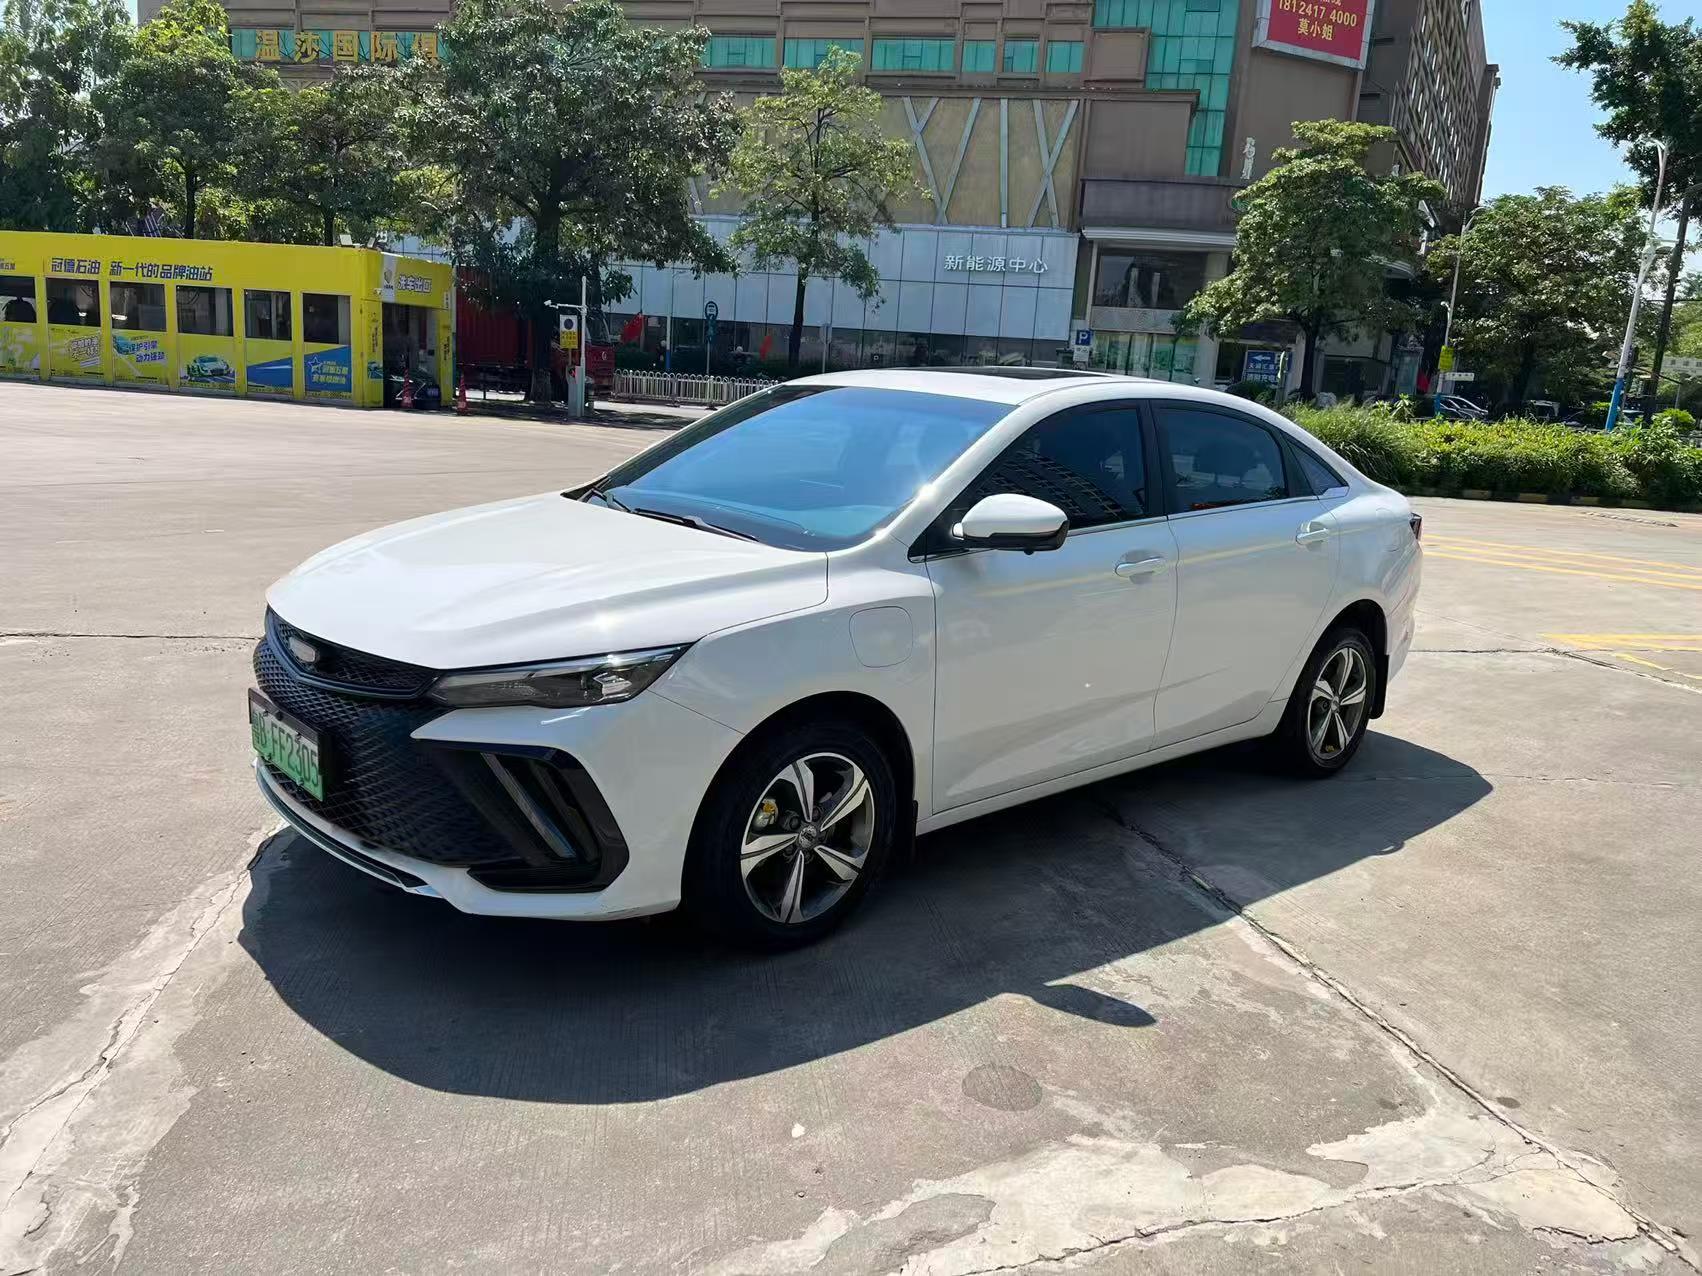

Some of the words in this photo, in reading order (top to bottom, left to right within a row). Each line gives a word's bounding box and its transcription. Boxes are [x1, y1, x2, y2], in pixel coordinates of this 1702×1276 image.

[1297, 17, 1334, 41] 莫小姐
[110, 260, 213, 281] 新一代的品牌油站
[943, 254, 1048, 274] 新能源中心
[398, 274, 432, 293] 洗车出口
[1079, 331, 1088, 344] P
